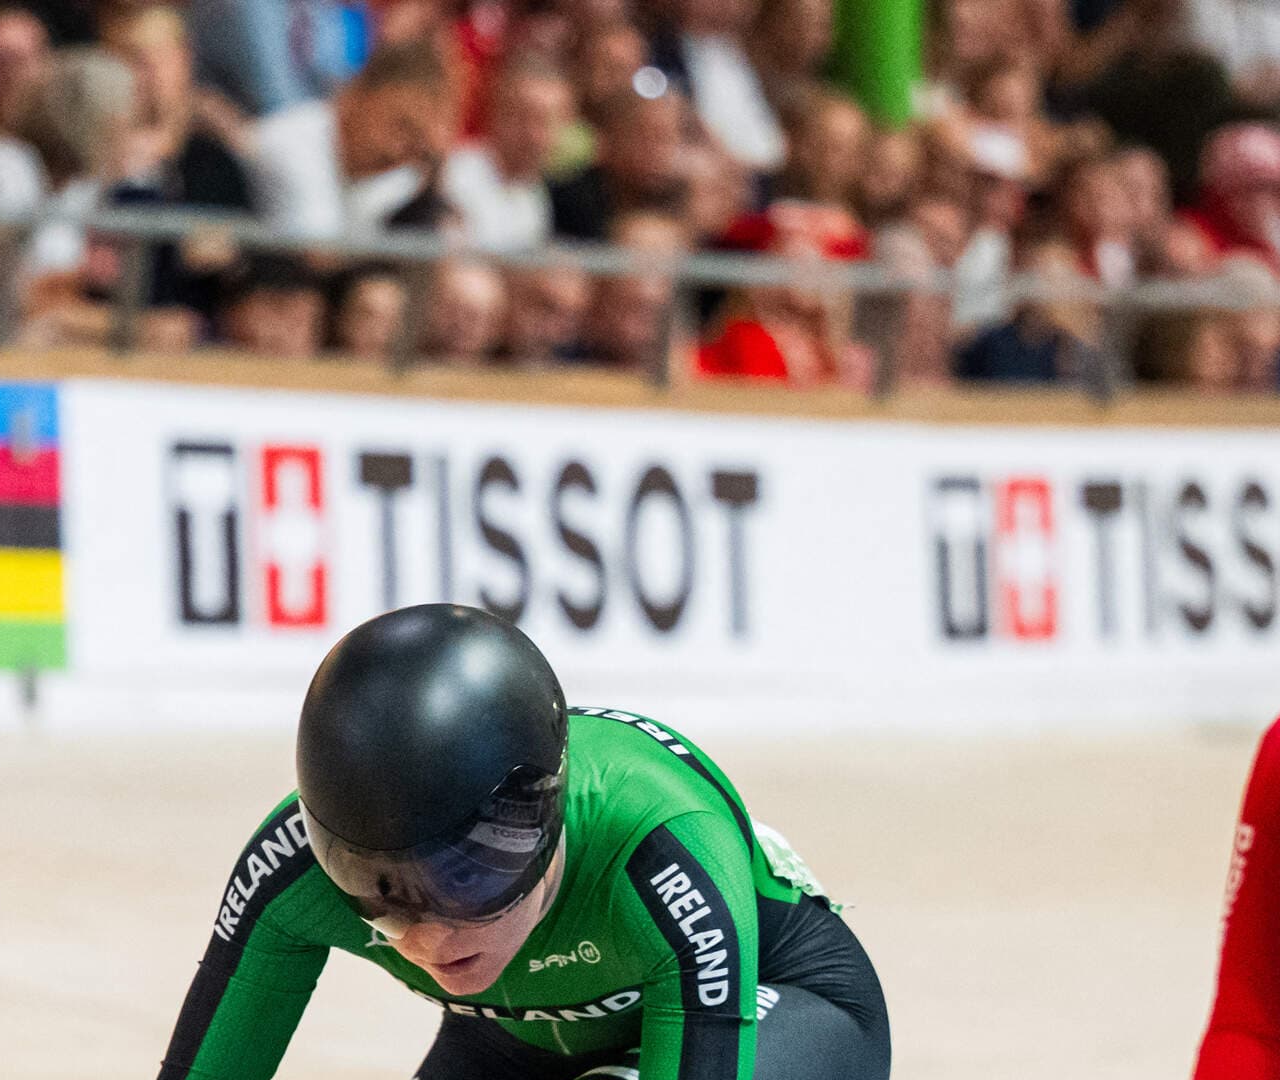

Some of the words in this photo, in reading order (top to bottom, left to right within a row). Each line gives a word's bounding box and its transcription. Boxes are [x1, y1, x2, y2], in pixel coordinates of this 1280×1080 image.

[359, 453, 758, 638] TISSOT
[214, 812, 309, 942] IRELAND
[649, 862, 729, 1007] IRELAND
